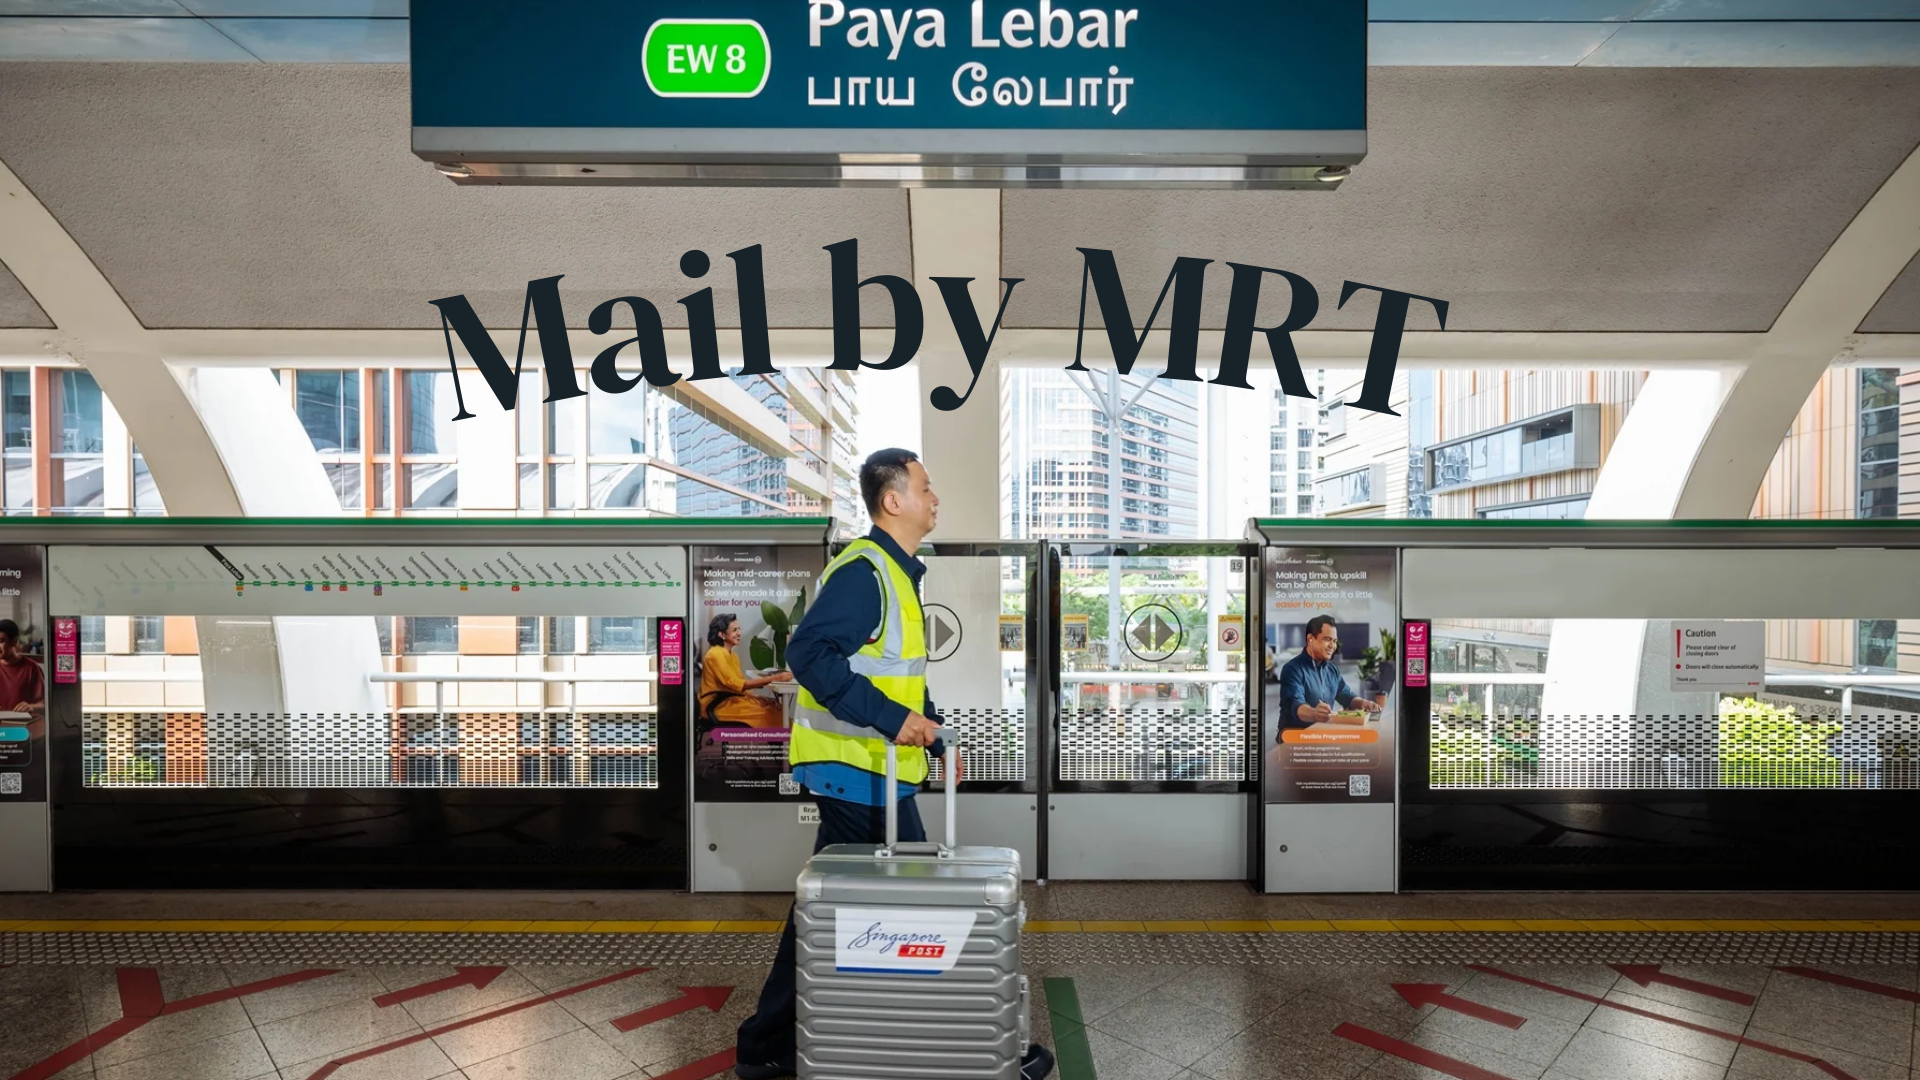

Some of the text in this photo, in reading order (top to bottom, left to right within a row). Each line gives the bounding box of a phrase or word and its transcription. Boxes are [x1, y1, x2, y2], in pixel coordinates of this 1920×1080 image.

[809, 0, 1139, 60] Paya Lebar
[666, 44, 747, 74] EW 8
[808, 61, 1134, 116] பாய லேபார்
[1232, 562, 1243, 571] 19
[704, 569, 811, 580] Making mid-career plans
[1275, 571, 1367, 581] Making time to upskill
[722, 579, 733, 587] be
[735, 579, 757, 587] hard.
[1293, 581, 1305, 589] be
[1306, 581, 1340, 589] difficult.
[2, 588, 21, 596] little
[704, 589, 715, 597] So
[716, 589, 740, 597] we've
[742, 589, 767, 597] made
[784, 589, 802, 597] little
[1275, 591, 1286, 599] So
[1288, 591, 1312, 599] we've
[1314, 591, 1339, 599] made
[1355, 591, 1373, 599] little
[704, 598, 730, 606] easier
[731, 598, 743, 606] for
[1316, 602, 1333, 610] you.
[1685, 629, 1717, 638] Caution
[847, 922, 948, 954] Singapore
[907, 946, 942, 956] POST
